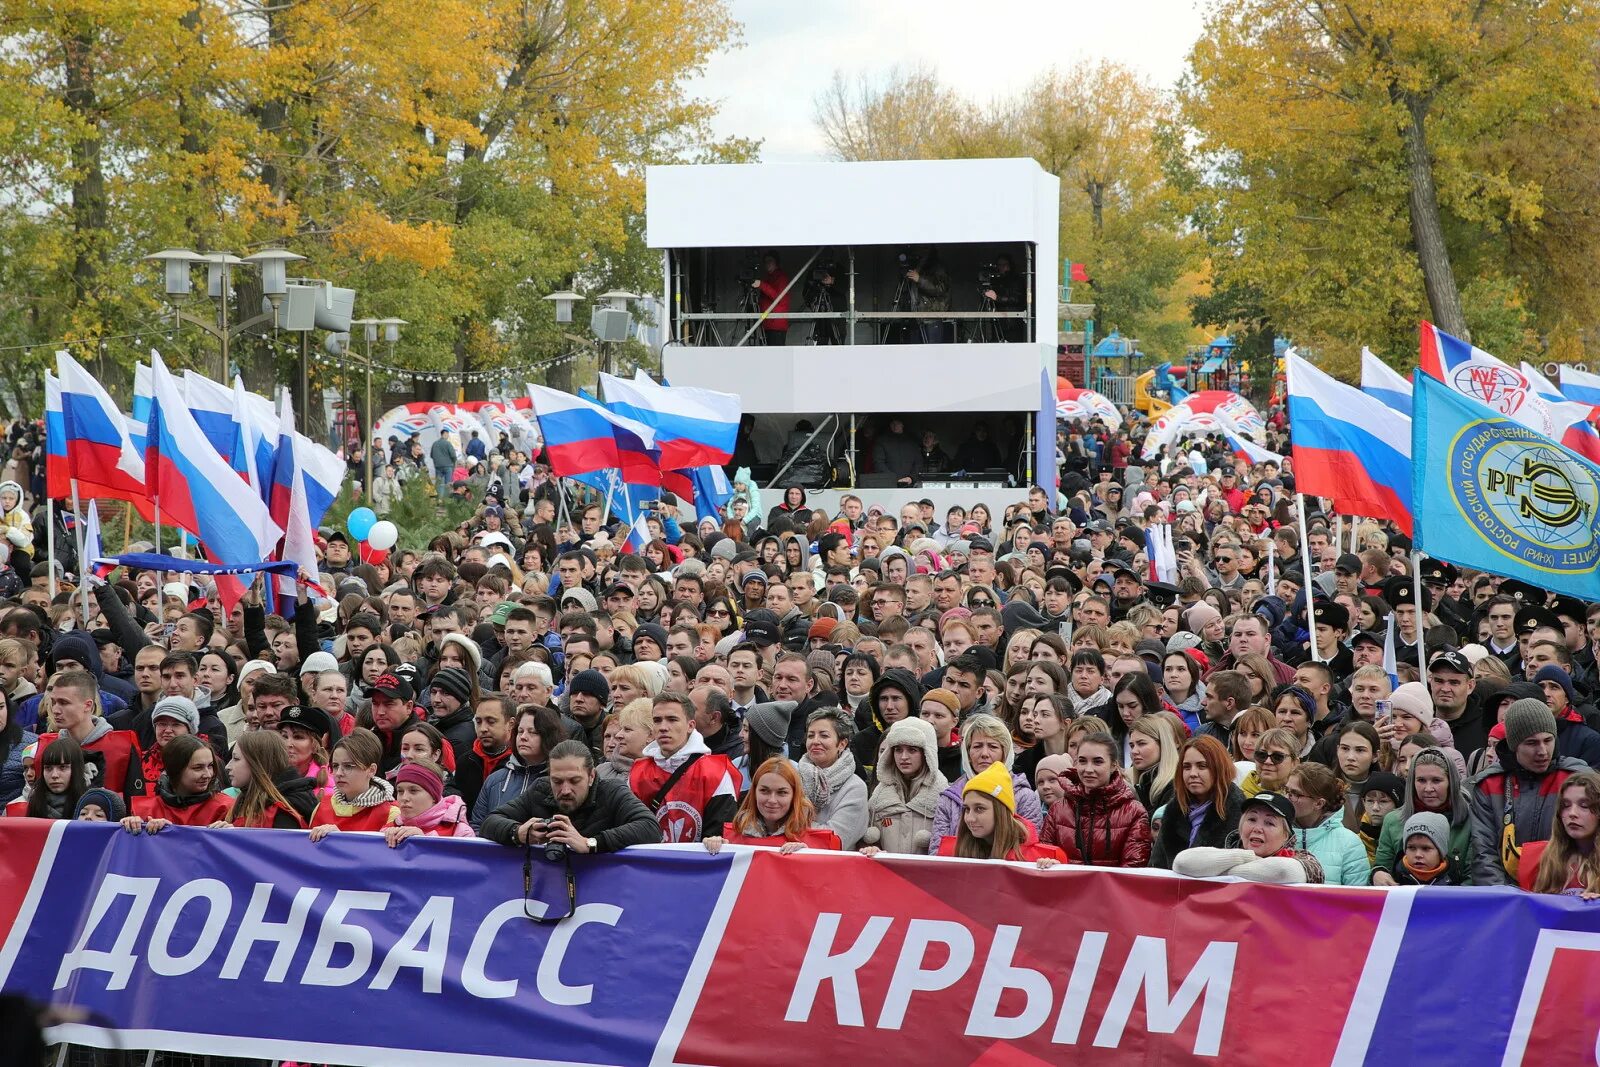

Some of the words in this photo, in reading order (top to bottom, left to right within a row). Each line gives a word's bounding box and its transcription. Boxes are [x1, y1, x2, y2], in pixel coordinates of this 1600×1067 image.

[1461, 427, 1547, 477] ГОСУДАРСВЕННЫ
[1460, 480, 1520, 550] РОСТОВСКИЙ
[1523, 547, 1555, 567] (РИНХ)
[496, 604, 509, 616] Z
[53, 873, 624, 1006] ДОНБАСС
[784, 912, 1239, 1057] КРЫМ
